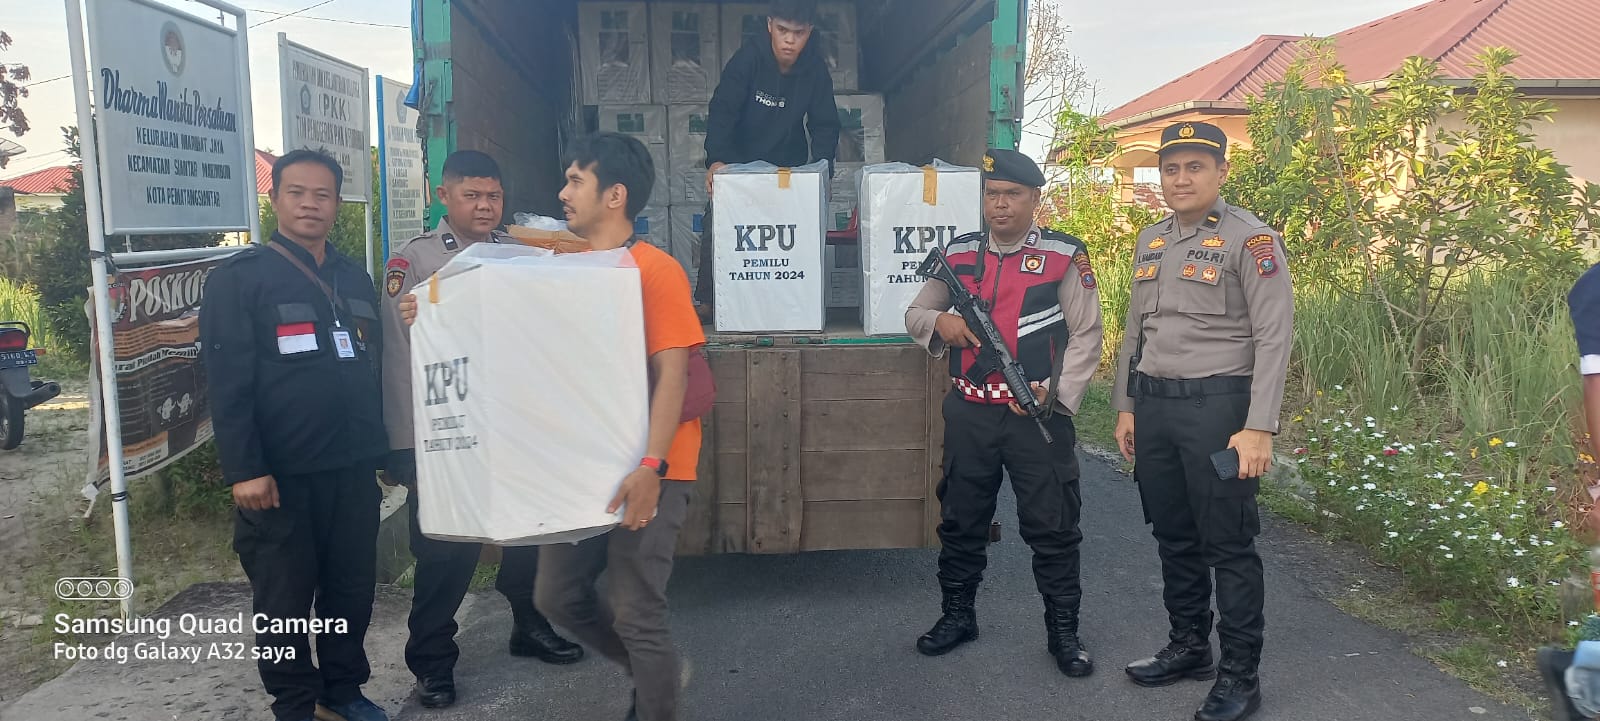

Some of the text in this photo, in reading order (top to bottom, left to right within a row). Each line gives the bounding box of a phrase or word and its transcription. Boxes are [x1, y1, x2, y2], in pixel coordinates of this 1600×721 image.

[101, 67, 236, 133] Dharma Wanita Persatuan
[136, 126, 179, 149] KELURAHAN
[209, 138, 224, 154] JAYA
[127, 154, 170, 175] KECAMATAN
[146, 186, 166, 205] KOTA
[734, 224, 797, 252] KPU
[892, 225, 957, 254] KPU
[743, 258, 789, 268] PEMILU
[1186, 249, 1225, 264] POLRI
[729, 270, 806, 281] TAHUN 2024
[424, 356, 469, 406] KPU
